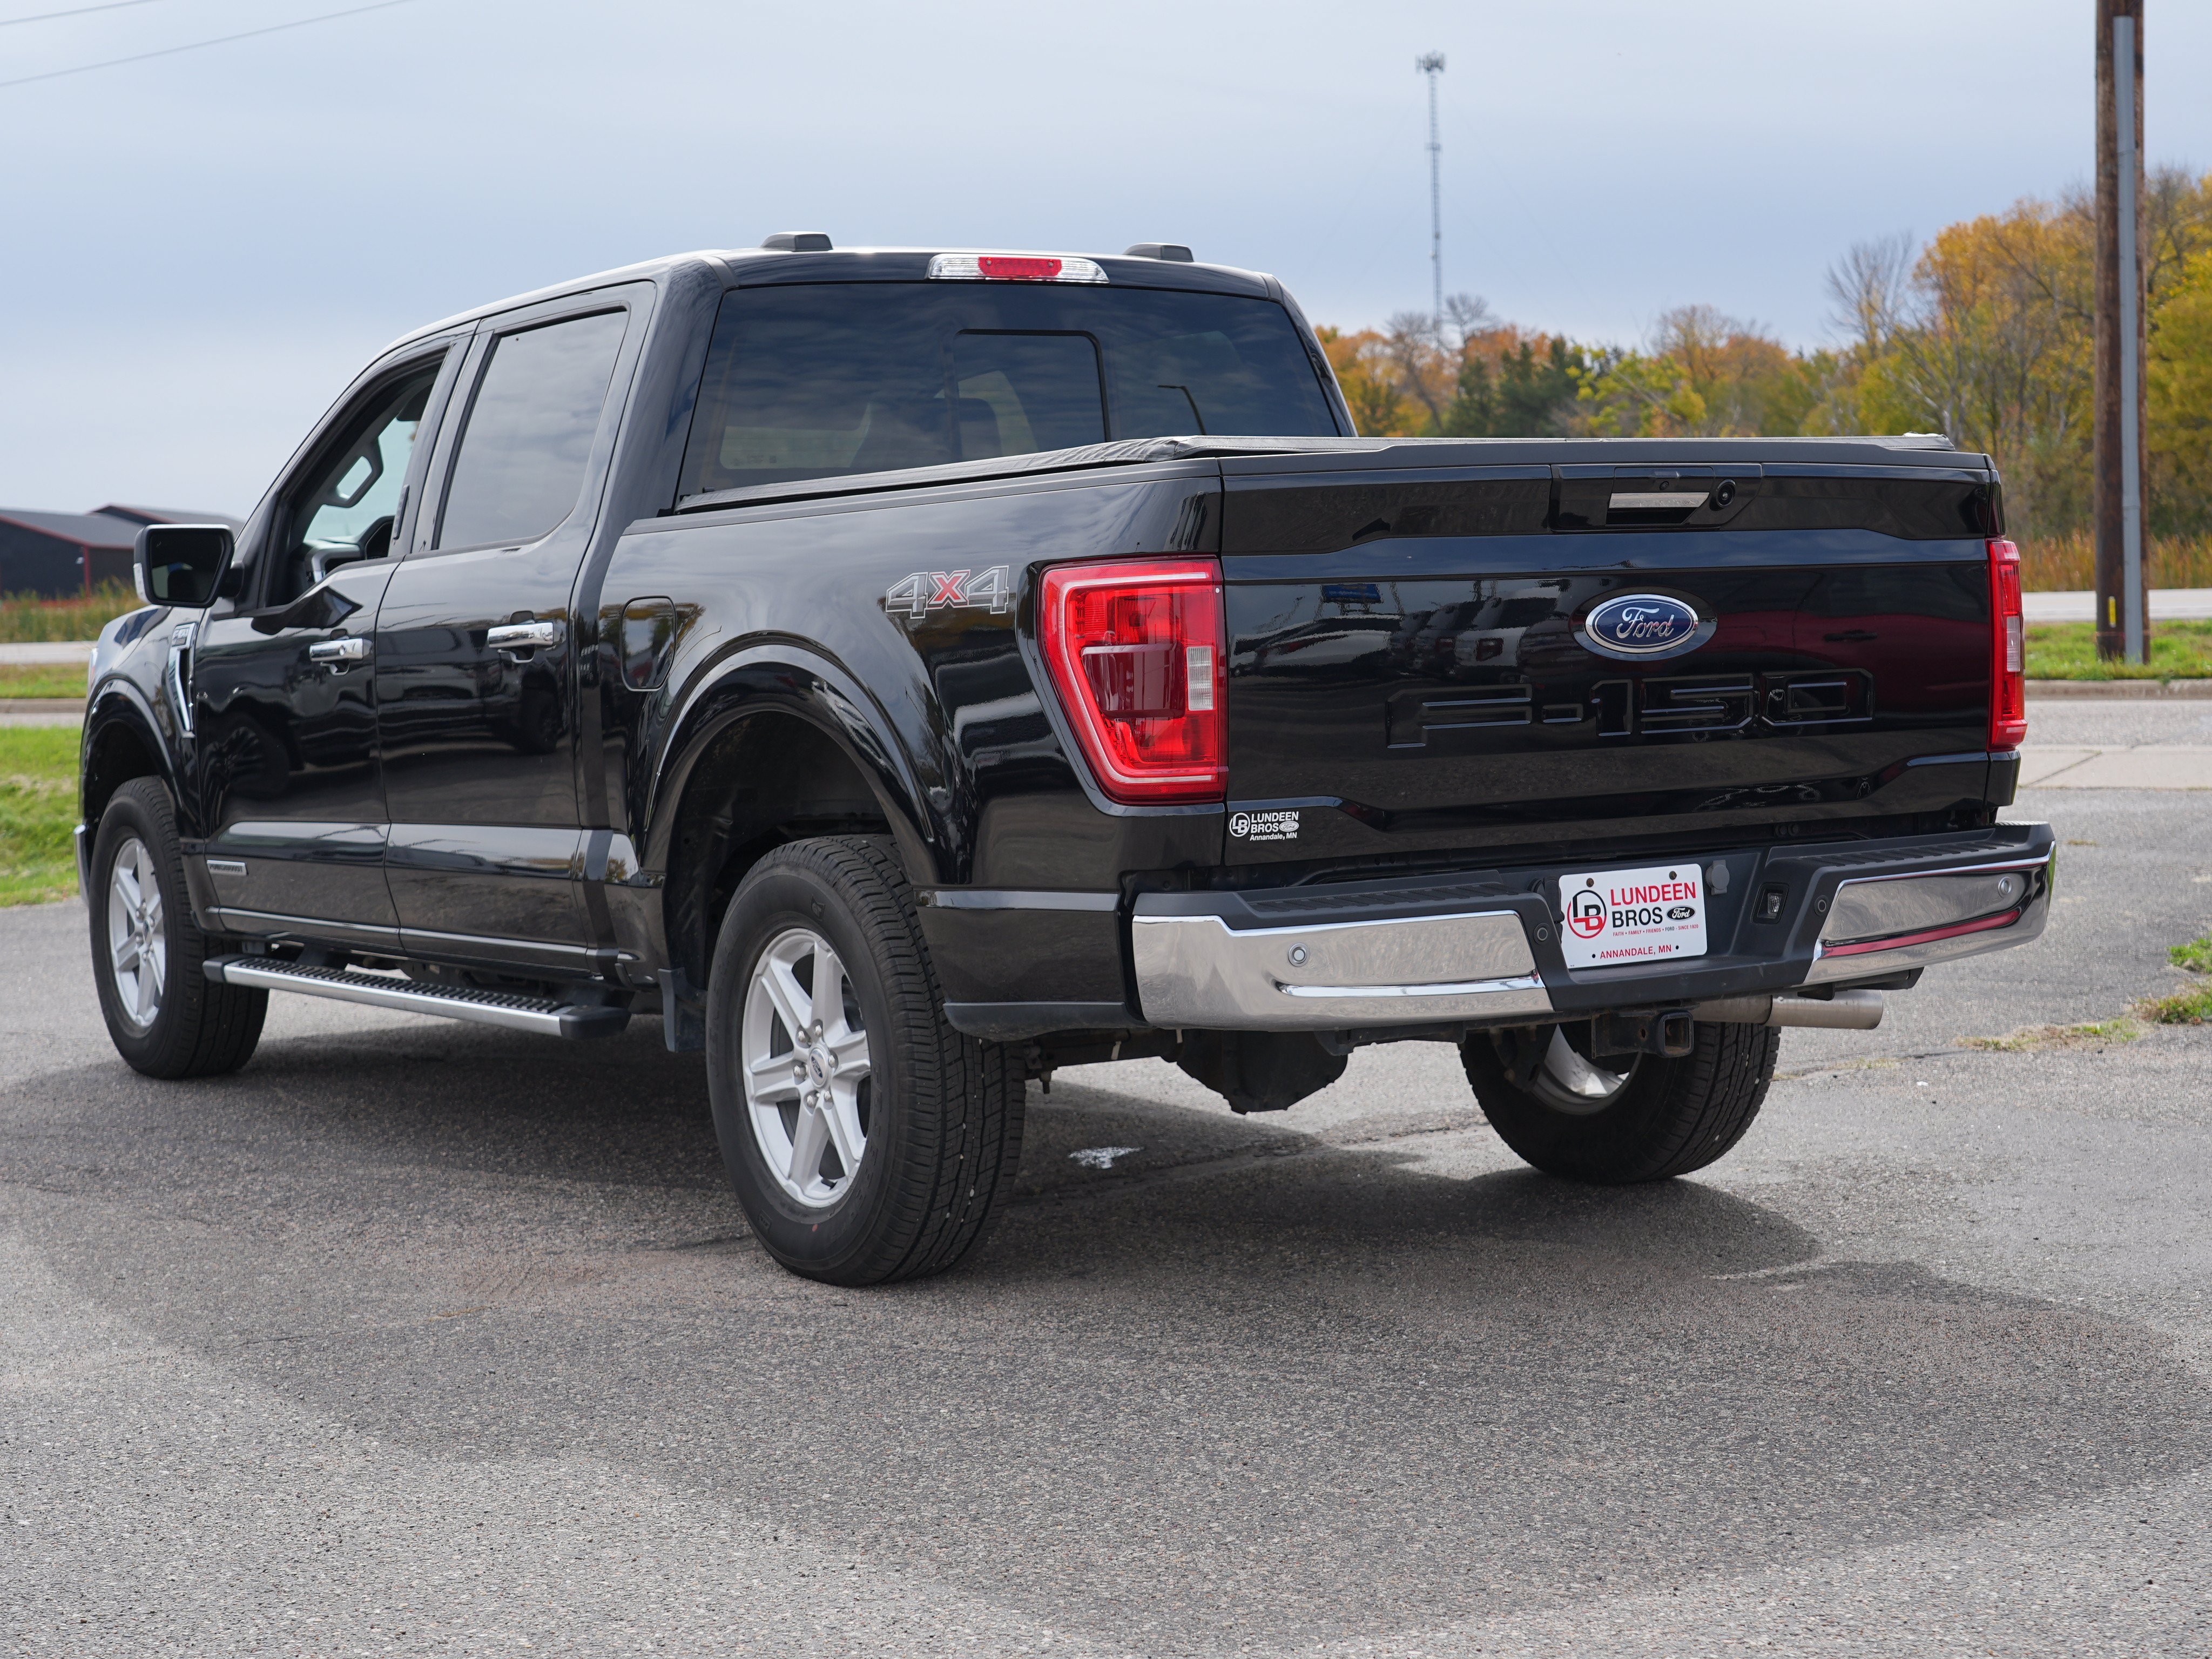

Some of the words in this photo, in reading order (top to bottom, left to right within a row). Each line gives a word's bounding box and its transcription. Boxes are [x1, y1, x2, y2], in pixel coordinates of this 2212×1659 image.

[1616, 606, 1675, 638] Ford
[1386, 668, 1875, 748] F-150
[1251, 811, 1299, 823] LUNDEEN
[1250, 822, 1279, 833] BROS
[1249, 833, 1285, 841] Annandale,
[1610, 881, 1696, 906] LUNDEEN
[1611, 907, 1663, 928] BROS
[1600, 946, 1656, 960] ANNANDALE,
[1658, 945, 1672, 954] MN
